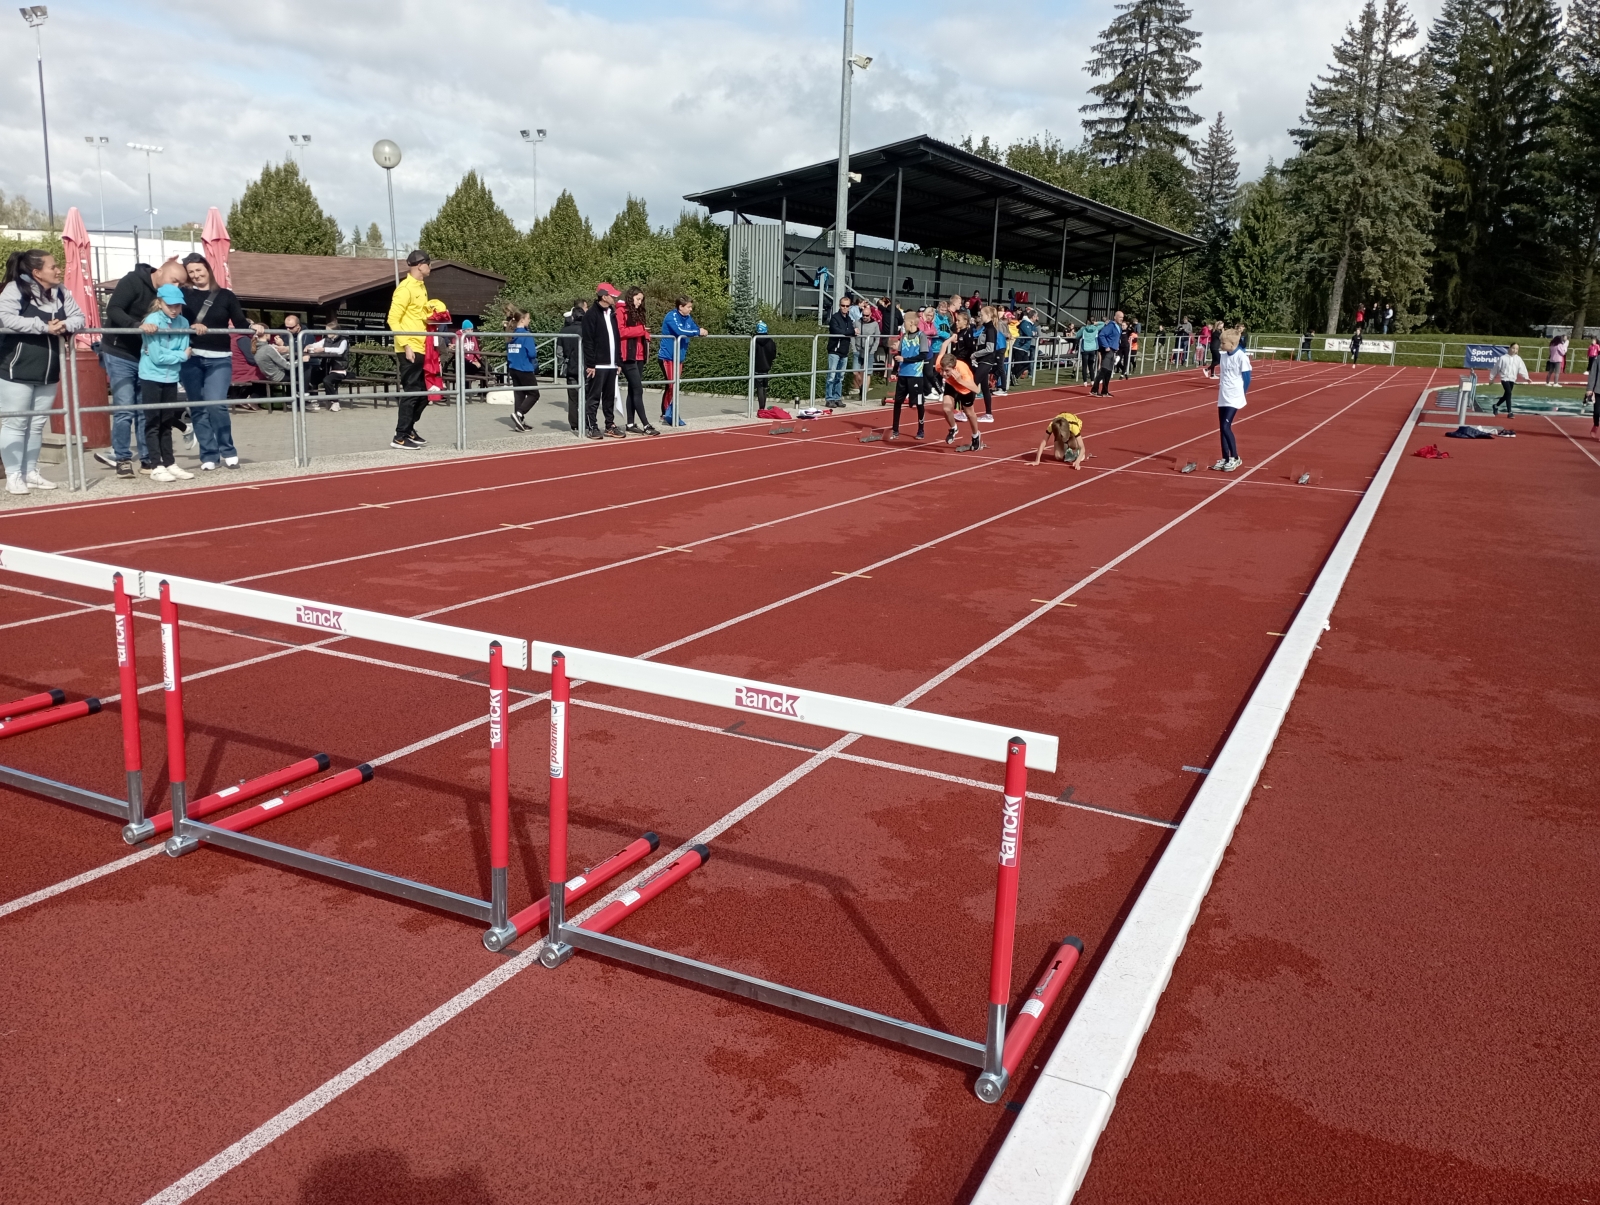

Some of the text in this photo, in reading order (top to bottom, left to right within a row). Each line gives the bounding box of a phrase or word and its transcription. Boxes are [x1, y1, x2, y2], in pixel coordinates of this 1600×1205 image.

[1471, 348, 1493, 356] Sport
[296, 605, 342, 630] Ranck
[735, 686, 798, 716] Ranck
[551, 720, 560, 765] polanik
